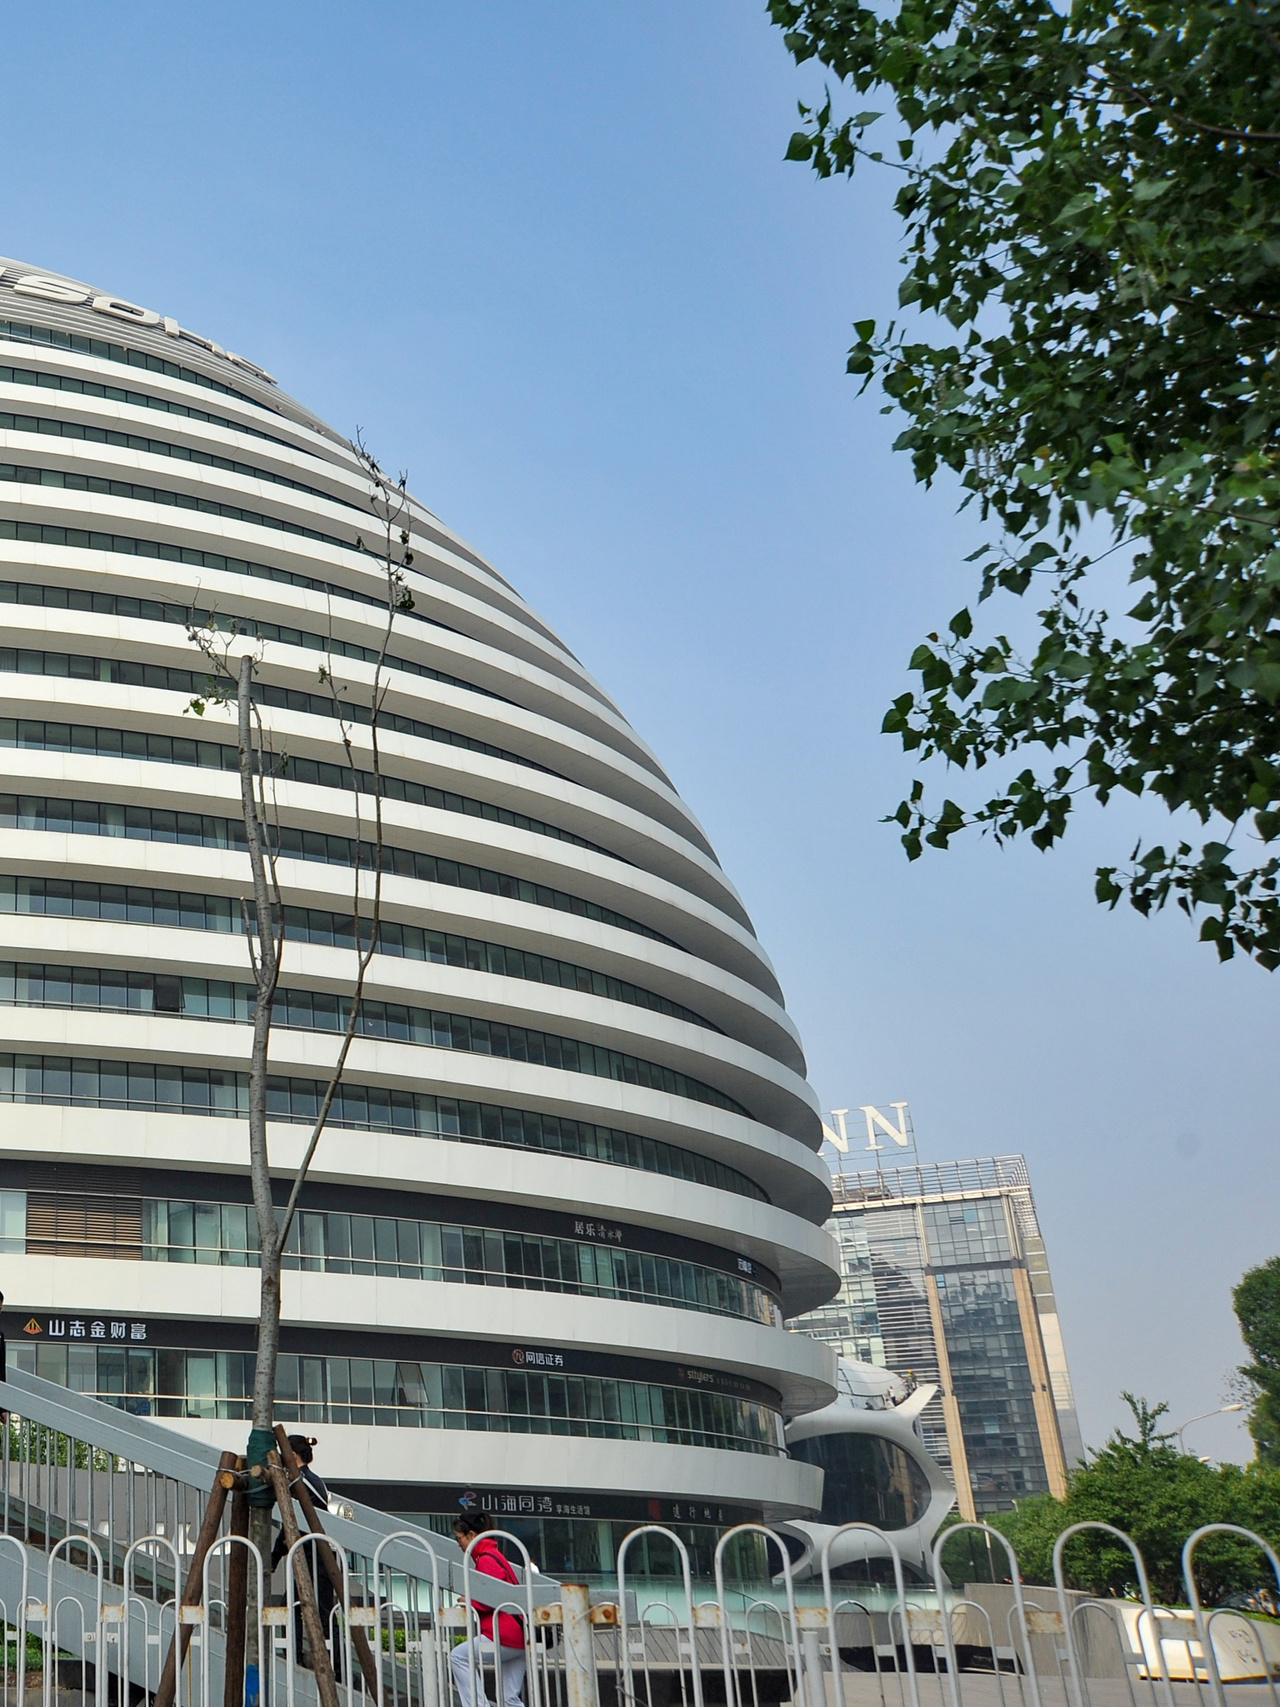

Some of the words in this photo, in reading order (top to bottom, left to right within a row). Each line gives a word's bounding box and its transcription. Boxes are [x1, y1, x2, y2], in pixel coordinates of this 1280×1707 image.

[49, 1319, 147, 1340] 山志金财富
[525, 1351, 564, 1367] 网信证券
[481, 1494, 553, 1513] 山海同湾
